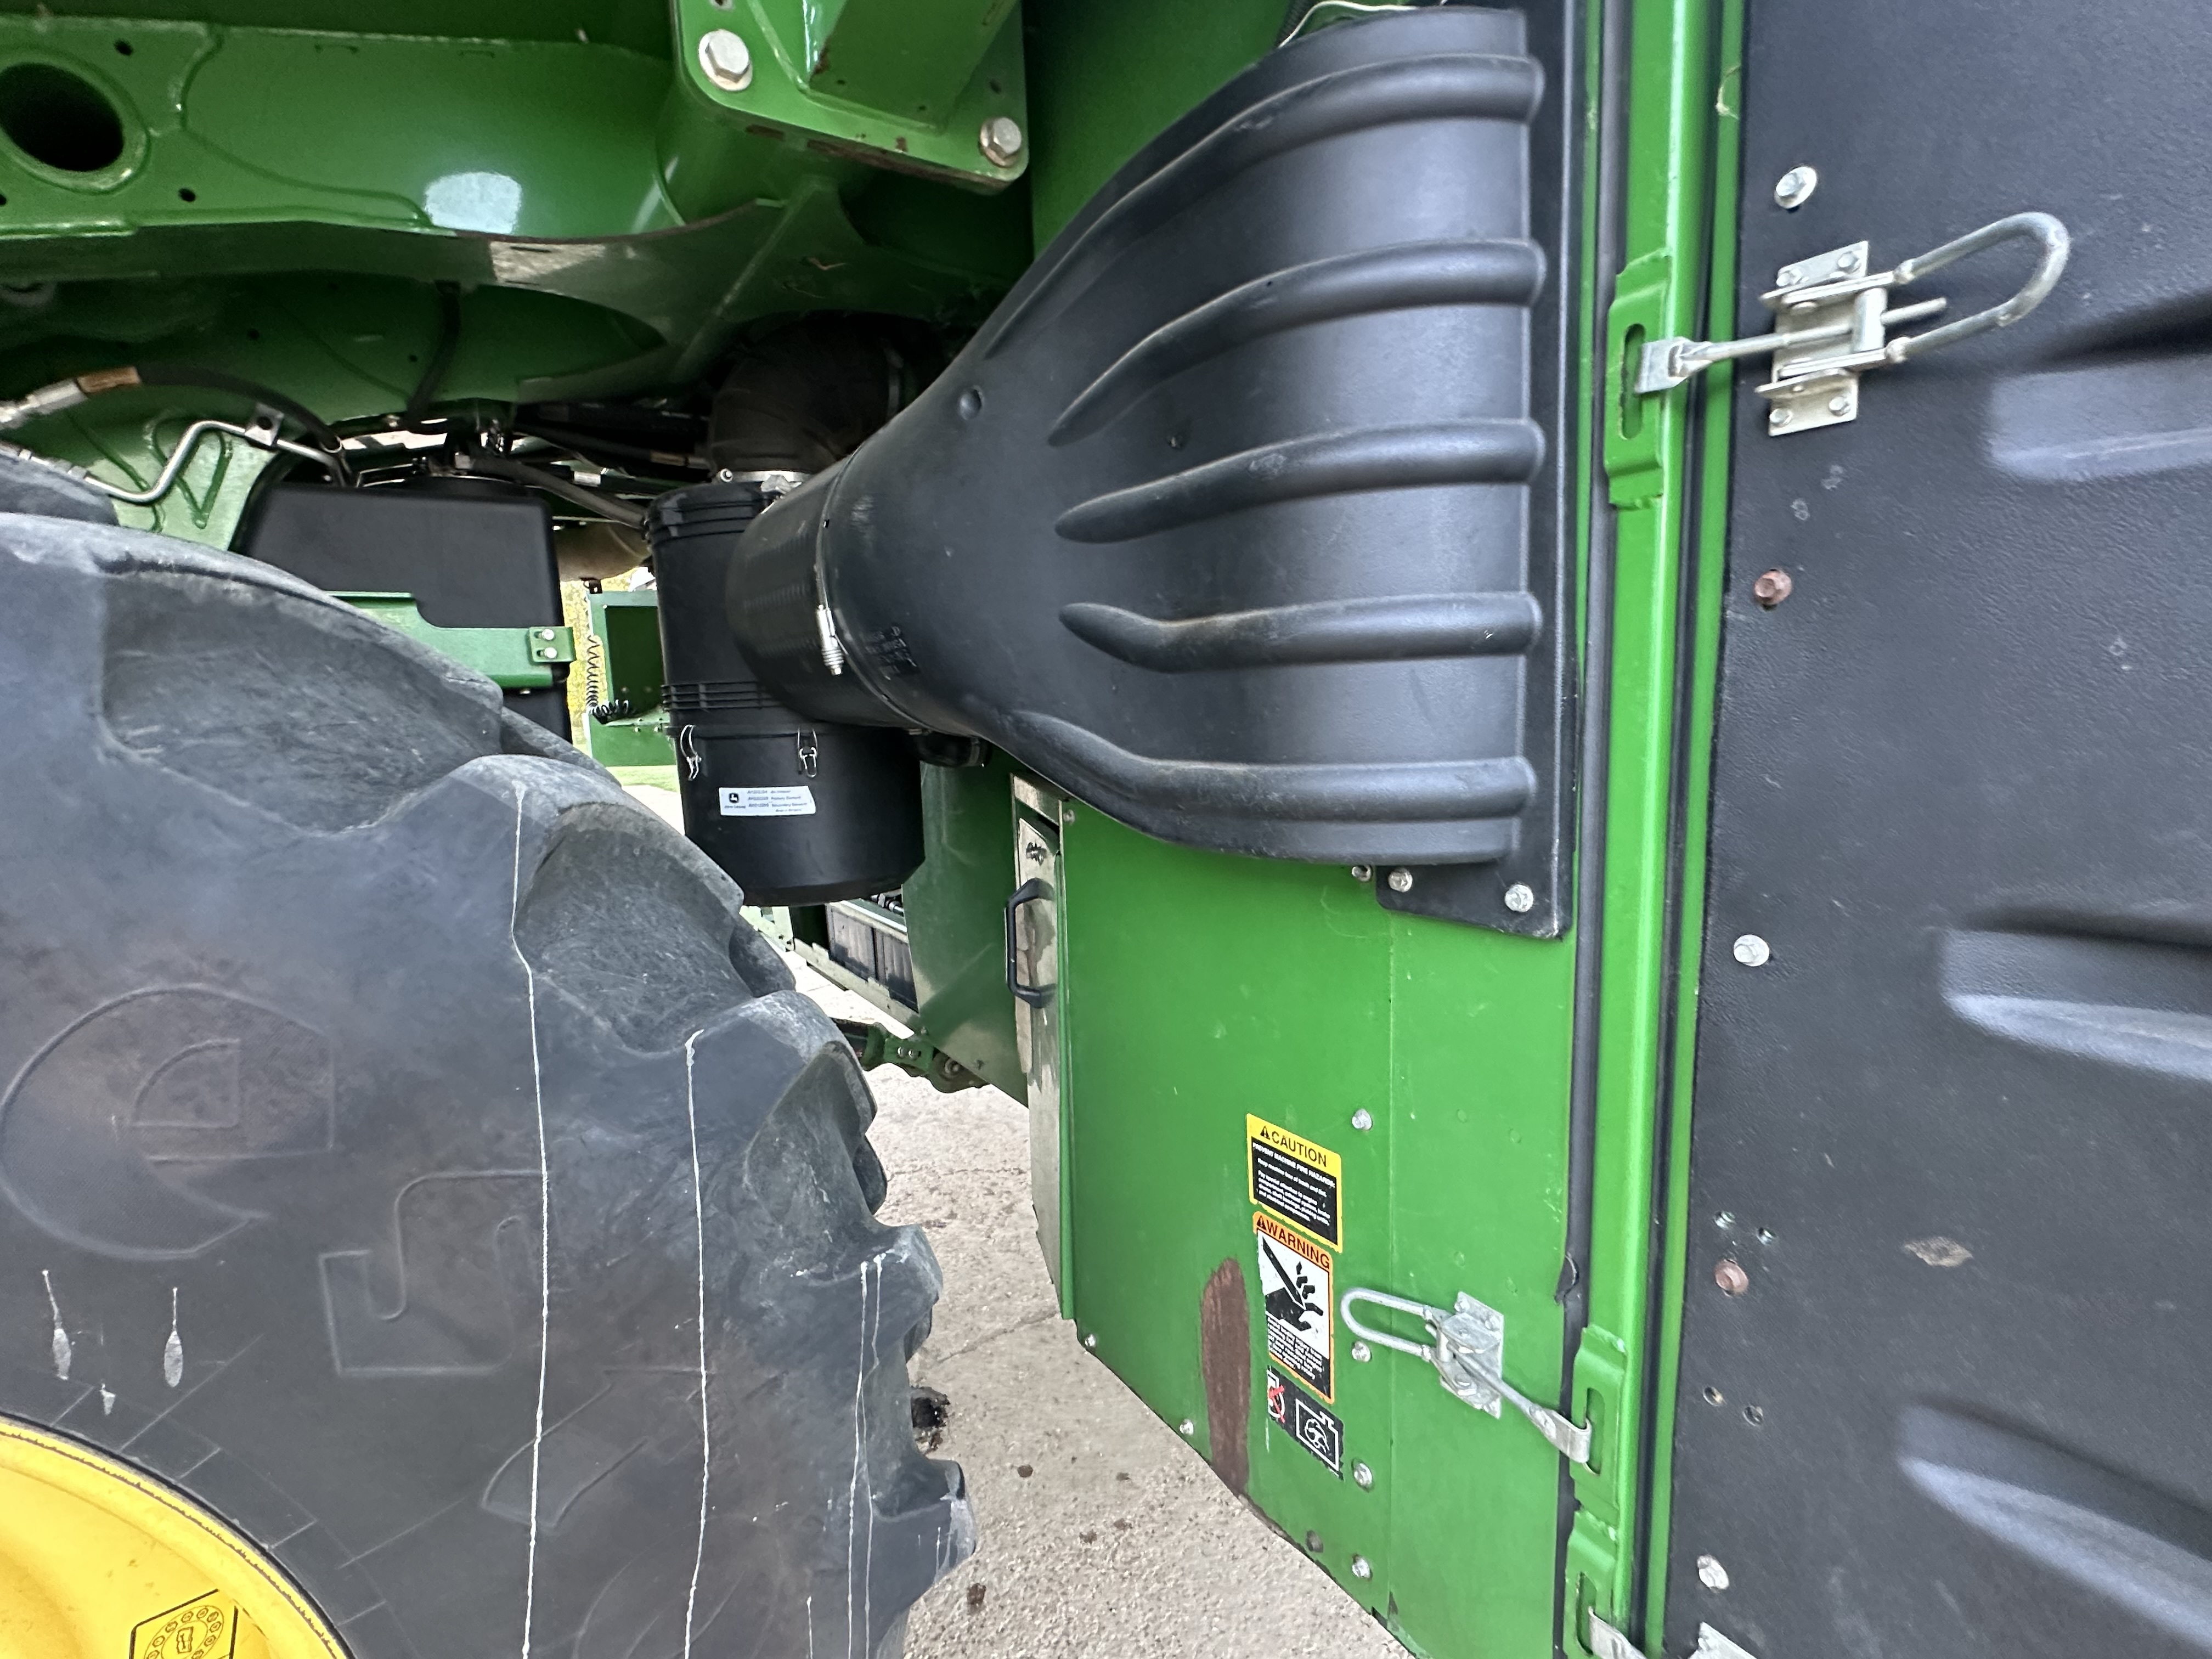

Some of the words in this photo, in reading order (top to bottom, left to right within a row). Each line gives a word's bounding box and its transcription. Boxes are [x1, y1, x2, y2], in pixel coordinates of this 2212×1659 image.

[1252, 1142, 1274, 1157] PREVENT
[1274, 1153, 1296, 1169] MACHINE
[1296, 1164, 1308, 1175] FIRE
[1272, 1131, 1327, 1167] CAUTION
[1267, 1220, 1330, 1269] WARNING
